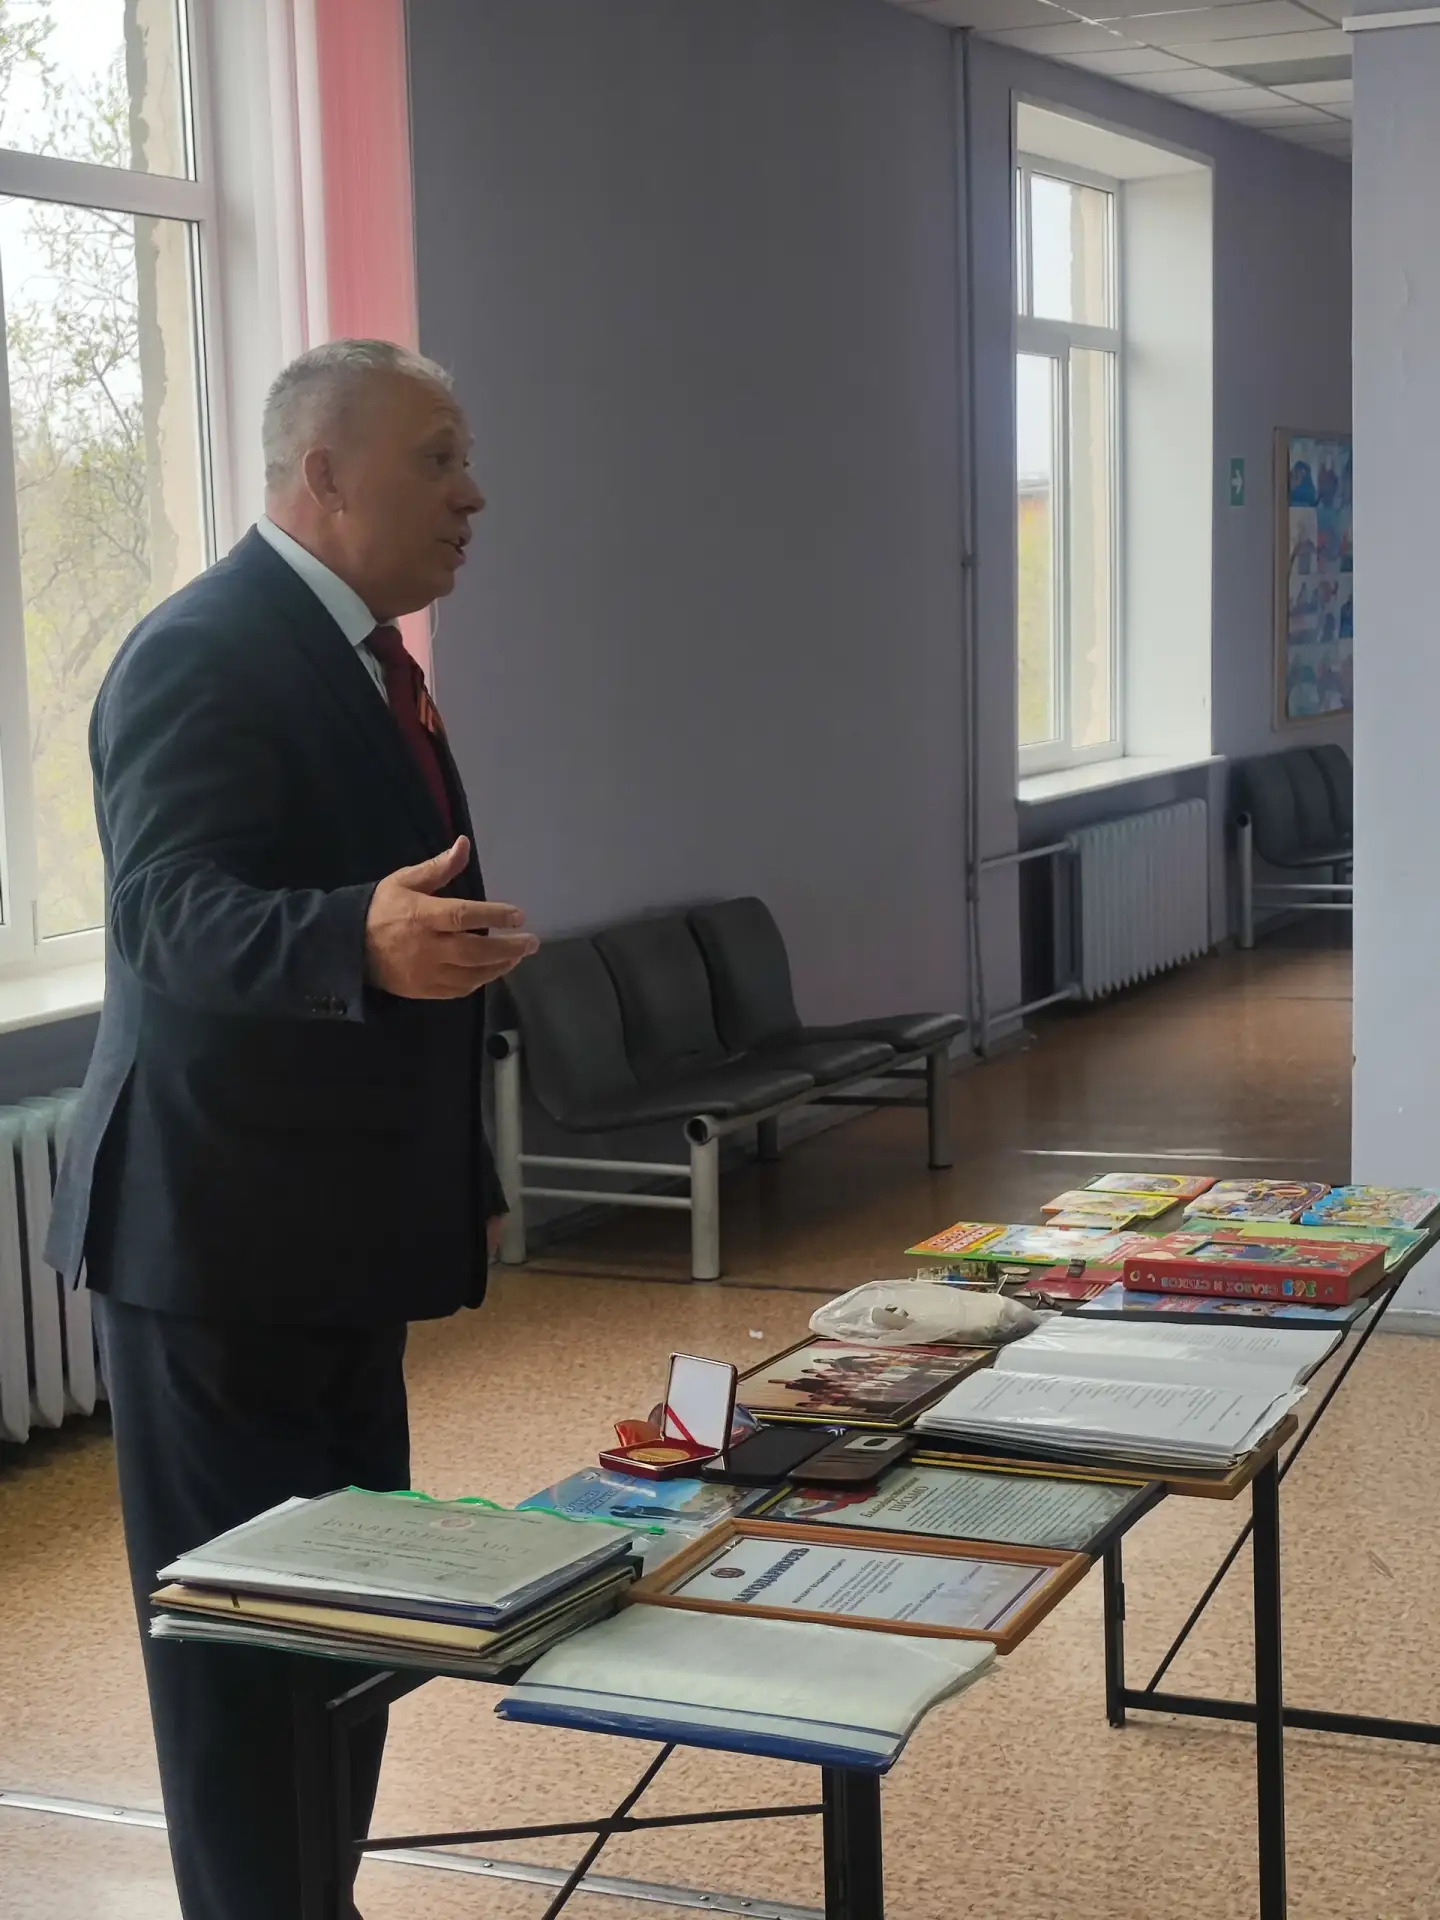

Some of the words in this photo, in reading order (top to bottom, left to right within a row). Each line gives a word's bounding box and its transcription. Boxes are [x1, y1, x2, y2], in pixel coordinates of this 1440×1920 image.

[1160, 1276, 1211, 1291] СТИХОВ
[1213, 1279, 1224, 1292] И
[1225, 1279, 1279, 1296] СКАЗОК
[1281, 1278, 1318, 1298] 365
[731, 1547, 811, 1604] ЛАГОДАРНОСТЬ
